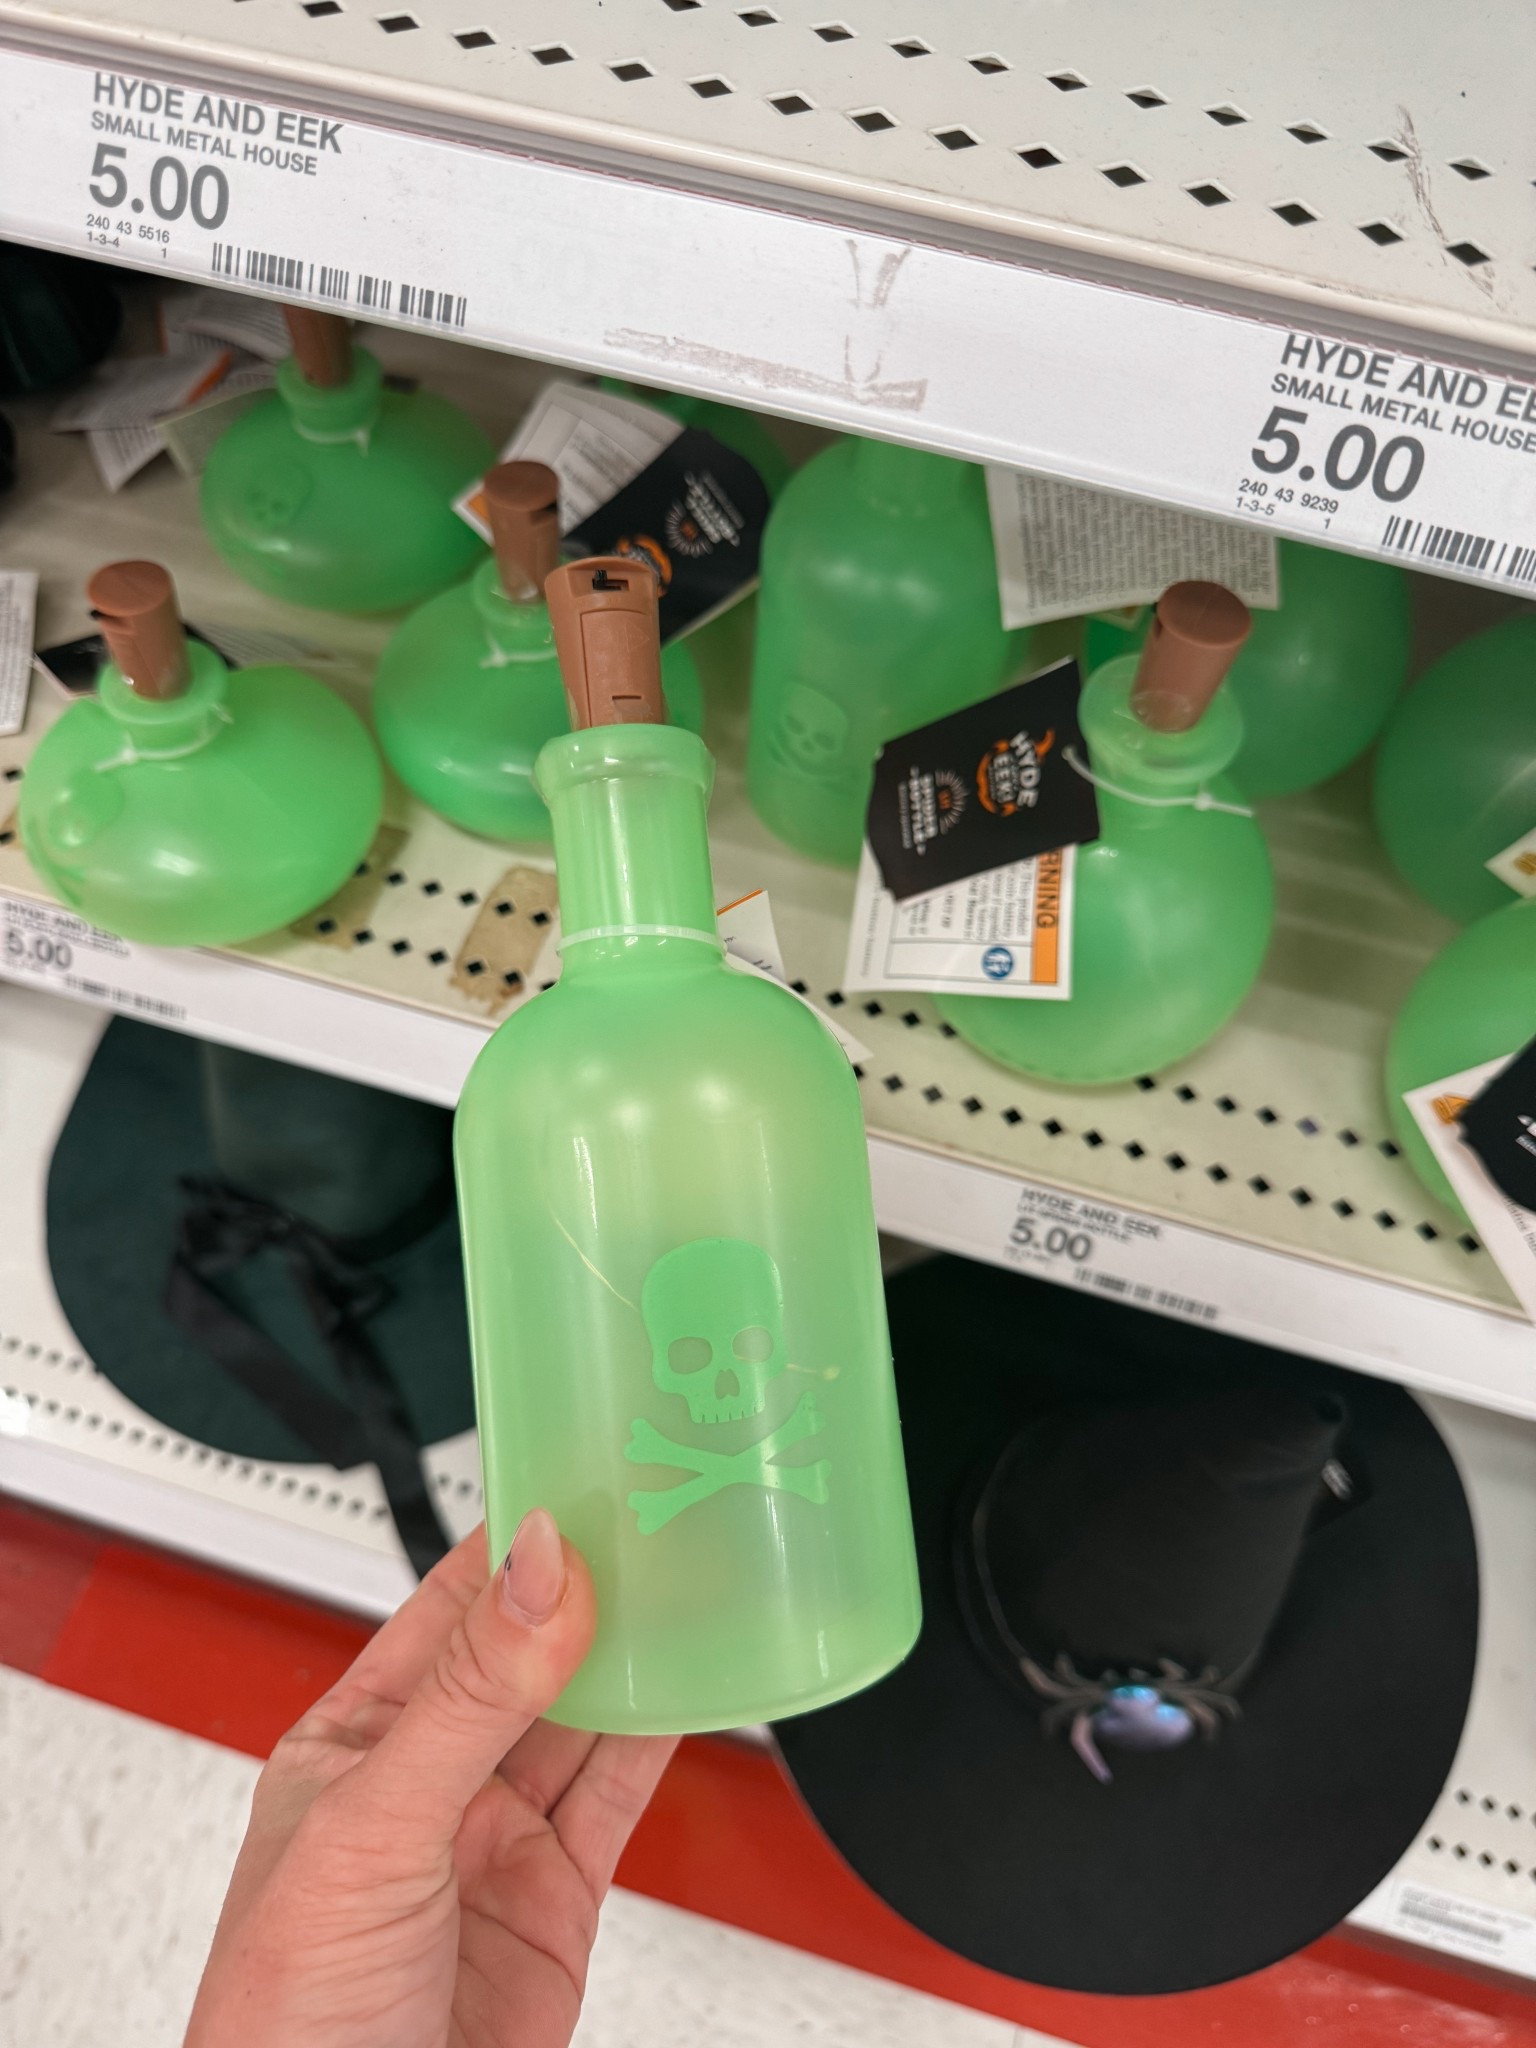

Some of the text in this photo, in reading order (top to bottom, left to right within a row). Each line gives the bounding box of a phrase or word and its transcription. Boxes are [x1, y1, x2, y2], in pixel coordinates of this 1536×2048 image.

[91, 111, 317, 176] SMALL METAL HOUSE
[93, 71, 344, 154] HYDE AND EEK
[89, 142, 229, 230] 5.00
[87, 213, 170, 243] 240 43 5516
[87, 231, 120, 248] 1-3-4
[1280, 334, 1536, 423] HYDE AND EE
[1271, 373, 1536, 453] SMALL METAL HOUSE
[1251, 405, 1425, 503] 5.00
[1236, 497, 1275, 516] 1-3-5
[1239, 479, 1339, 514] 240 43 9239
[1010, 730, 1041, 808] HYDE
[1037, 851, 1061, 929] RNING
[6, 928, 72, 970] 5.00
[1010, 1217, 1092, 1260] 5.00
[1079, 1204, 1117, 1224] AND
